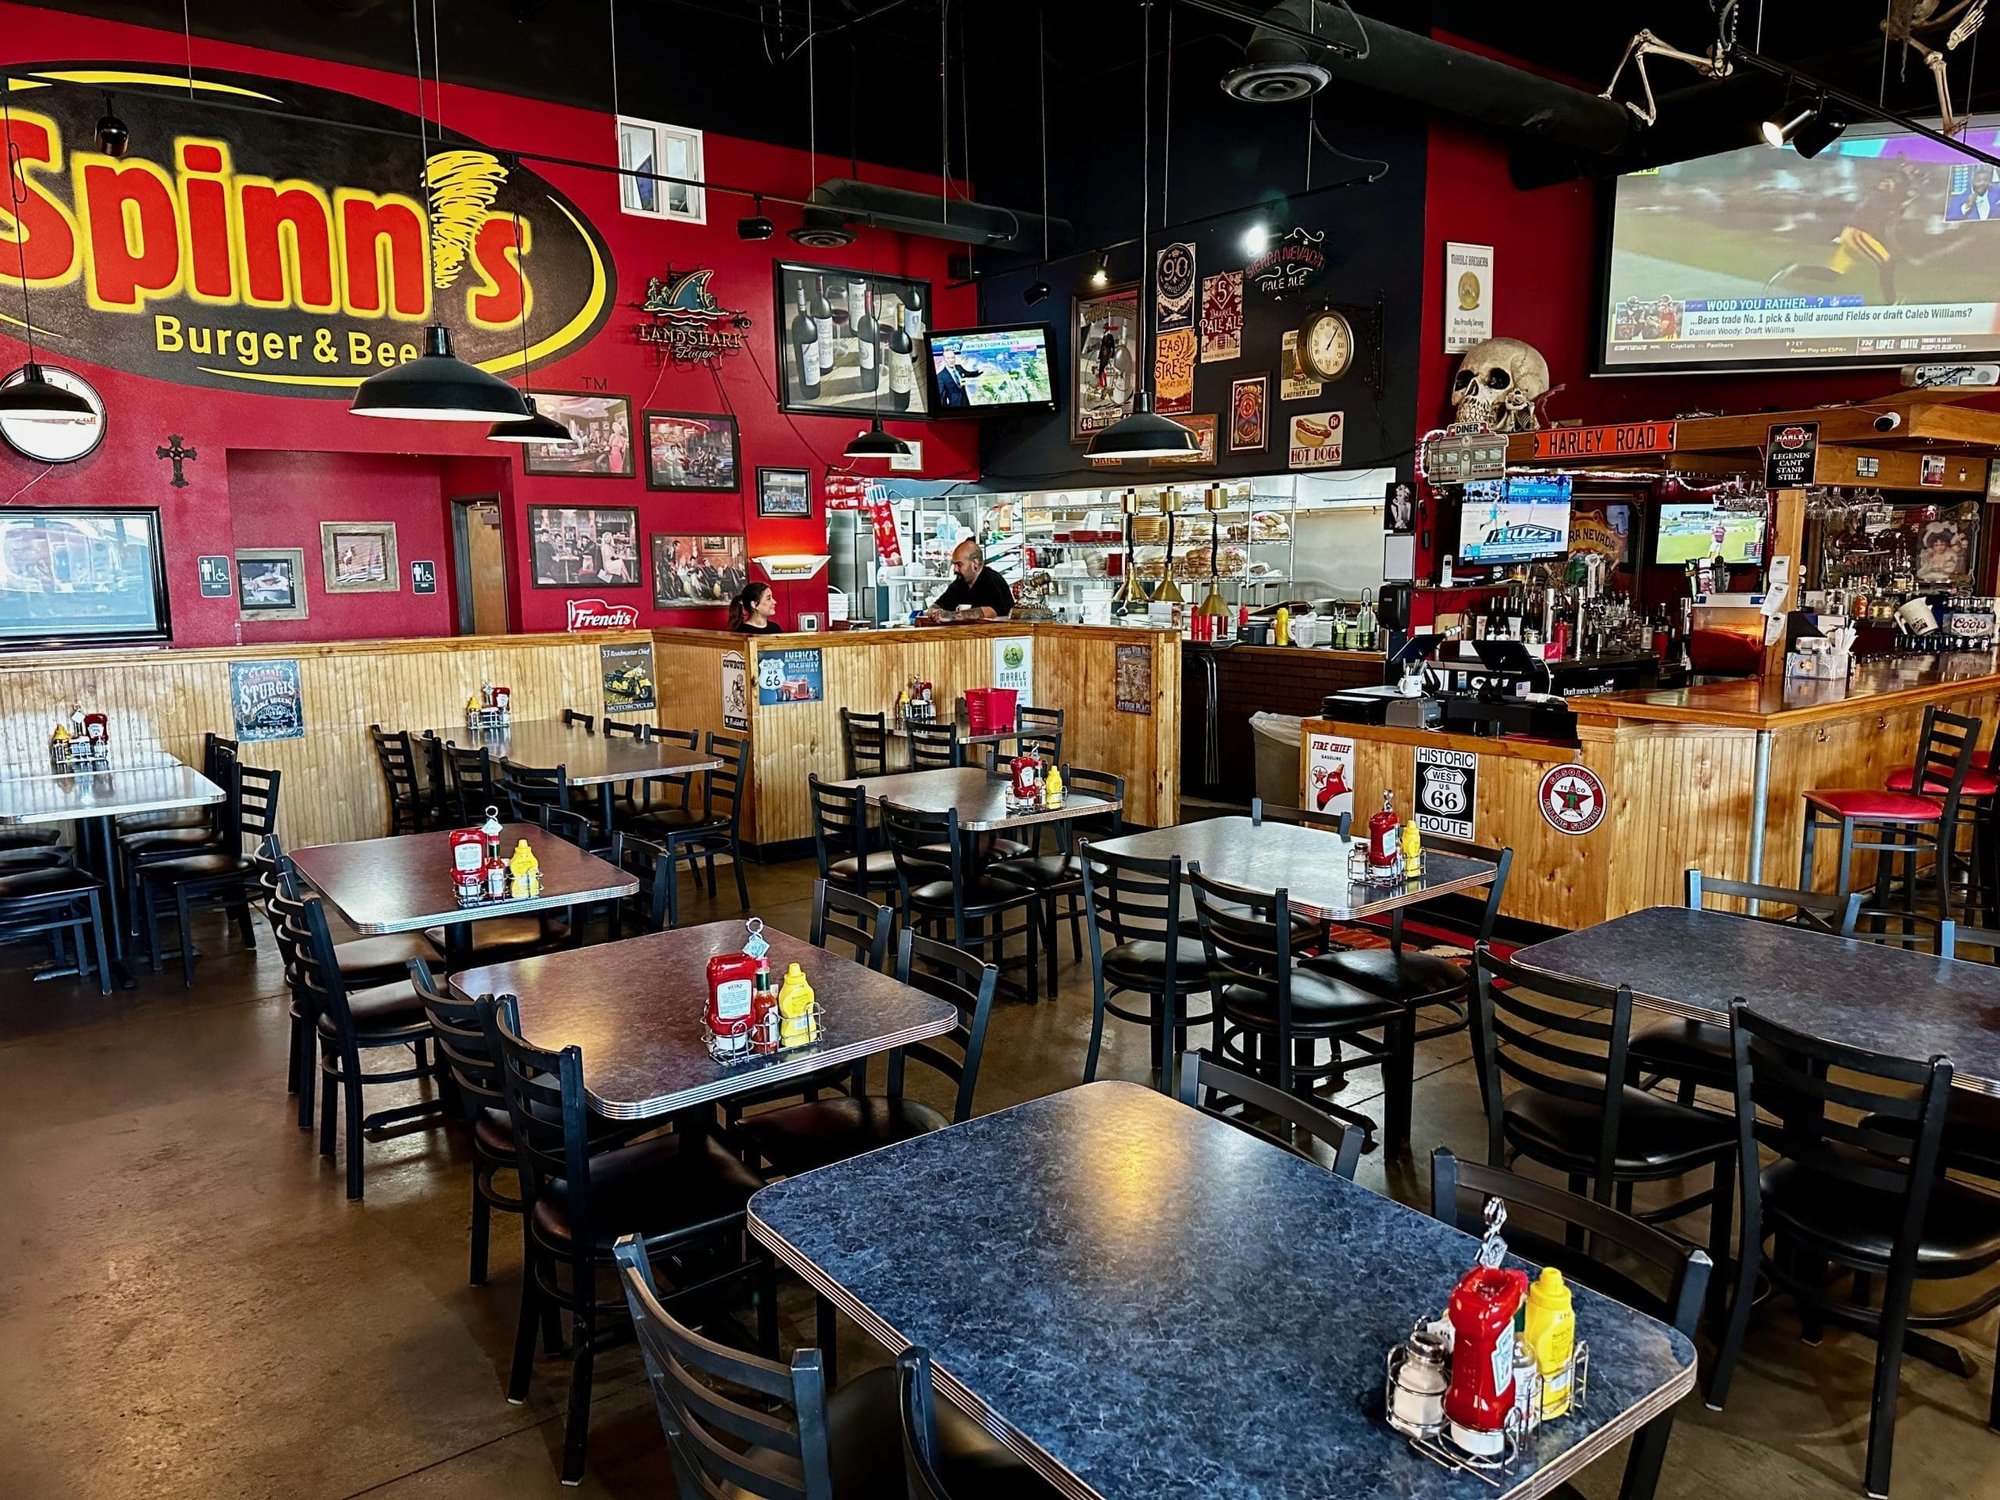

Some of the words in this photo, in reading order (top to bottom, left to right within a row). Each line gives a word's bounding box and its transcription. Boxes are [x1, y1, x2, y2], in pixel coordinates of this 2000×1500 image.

[1163, 257, 1188, 280] 90
[1245, 249, 1281, 279] SIERRA
[1282, 245, 1325, 269] NEVADA
[1217, 281, 1227, 302] 5
[1262, 278, 1285, 292] PALE
[1287, 275, 1306, 287] ALE
[1706, 300, 1737, 311] WOOD
[1739, 299, 1761, 310] YOU
[1199, 318, 1224, 334] PALE
[1226, 315, 1244, 331] ALE
[1721, 314, 1742, 324] trade
[1743, 313, 1757, 323] No.
[1758, 313, 1763, 323] 1
[1765, 312, 1783, 325] pick
[1784, 313, 1792, 322] &
[1793, 312, 1814, 322] build
[1815, 312, 1844, 321] around
[1846, 310, 1870, 320] Fields
[1872, 312, 1882, 320] or
[1883, 309, 1904, 320] draft
[1905, 308, 1930, 319] Caleb
[1931, 307, 1973, 319] Williams?
[639, 323, 743, 348] LANDSHARK
[1689, 328, 1716, 336] Damien
[1745, 326, 1763, 334] Draft
[1764, 325, 1795, 334] Williams
[155, 315, 302, 366] Burger
[313, 328, 339, 364] &
[348, 331, 419, 367] Bee
[1159, 335, 1185, 358] EASY
[1875, 339, 1895, 349] LOPEZ
[1900, 338, 1919, 349] ORTIZ
[1155, 358, 1193, 380] STREET
[582, 377, 607, 390] TM
[1283, 390, 1306, 399] ANOTHER
[1307, 388, 1320, 396] BEER
[1082, 418, 1093, 430] 48
[1456, 424, 1479, 433] DINER
[1550, 429, 1604, 455] HARLEY
[1616, 426, 1657, 450] ROAD
[1776, 433, 1810, 441] HARLEY
[1291, 448, 1311, 463] HOT
[1314, 446, 1340, 460] DOGS
[1773, 452, 1810, 460] LEGENDS
[1583, 527, 1616, 551] NEVADA
[574, 609, 632, 628] French's
[1953, 618, 1987, 629] Coors
[766, 675, 780, 687] 66
[1000, 671, 1026, 681] MARBLE
[239, 680, 295, 714] STURGIS
[606, 702, 655, 712] MOTORCYCLES
[1312, 741, 1329, 751] FIRE
[1330, 743, 1352, 754] CHIEF
[1419, 748, 1474, 768] HISTORIC
[1433, 771, 1457, 782] WEST
[1549, 768, 1598, 791] GASOLINE
[1431, 790, 1458, 810] 66
[1544, 799, 1568, 828] FILLING
[1570, 805, 1601, 830] STATION
[1420, 815, 1469, 836] ROUTE
